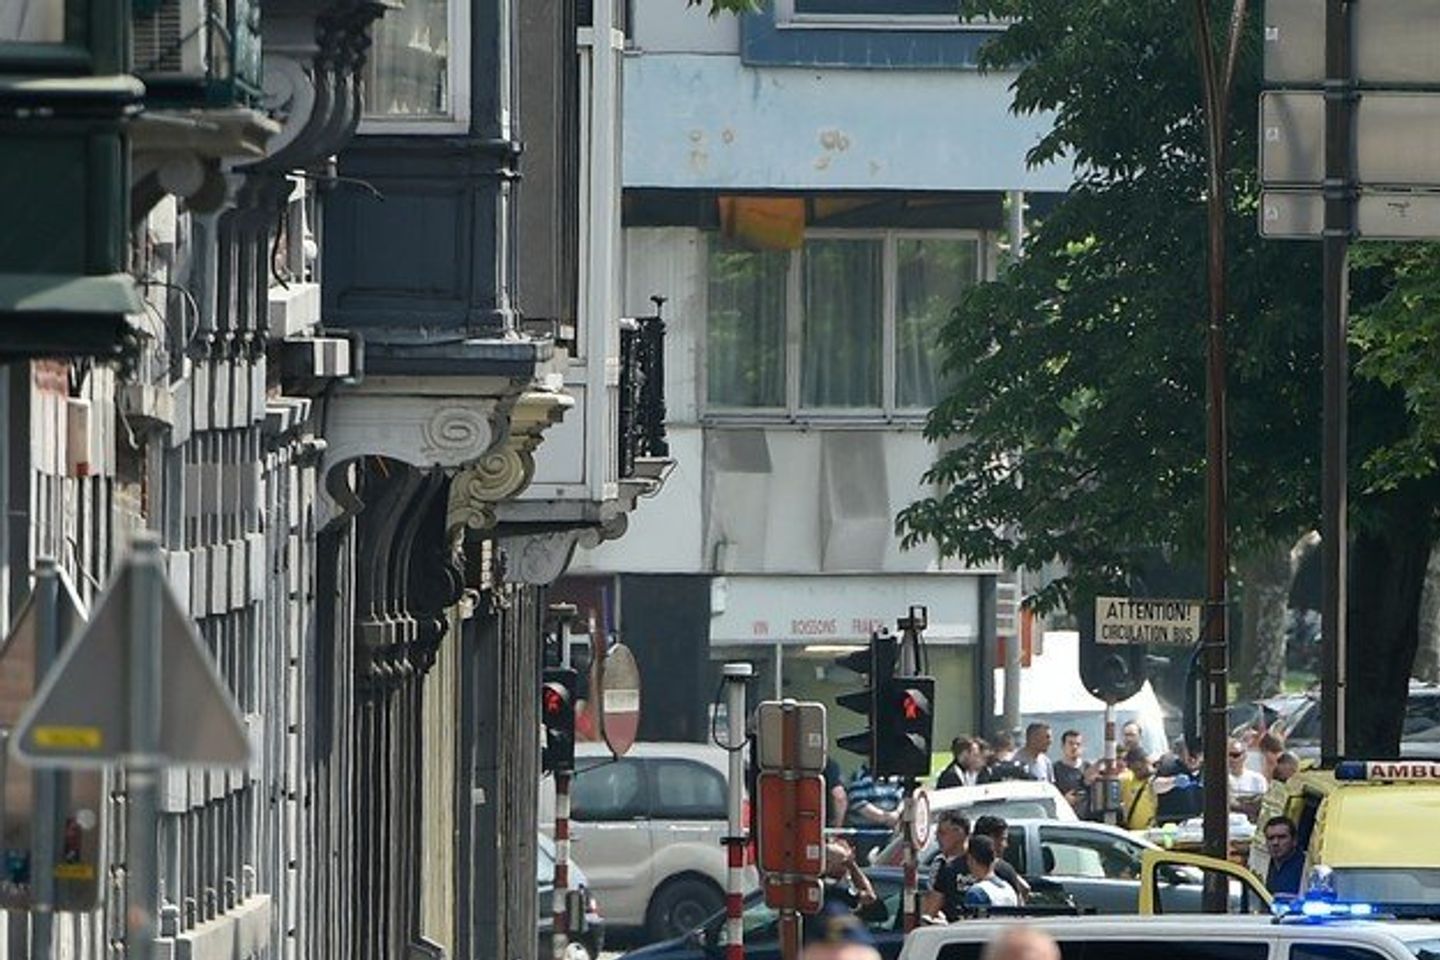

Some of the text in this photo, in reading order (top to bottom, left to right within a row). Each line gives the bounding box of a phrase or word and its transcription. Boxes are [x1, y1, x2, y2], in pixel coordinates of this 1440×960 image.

[1106, 601, 1191, 621] ATTENTION!
[1102, 624, 1193, 643] CIRCULATION BUS
